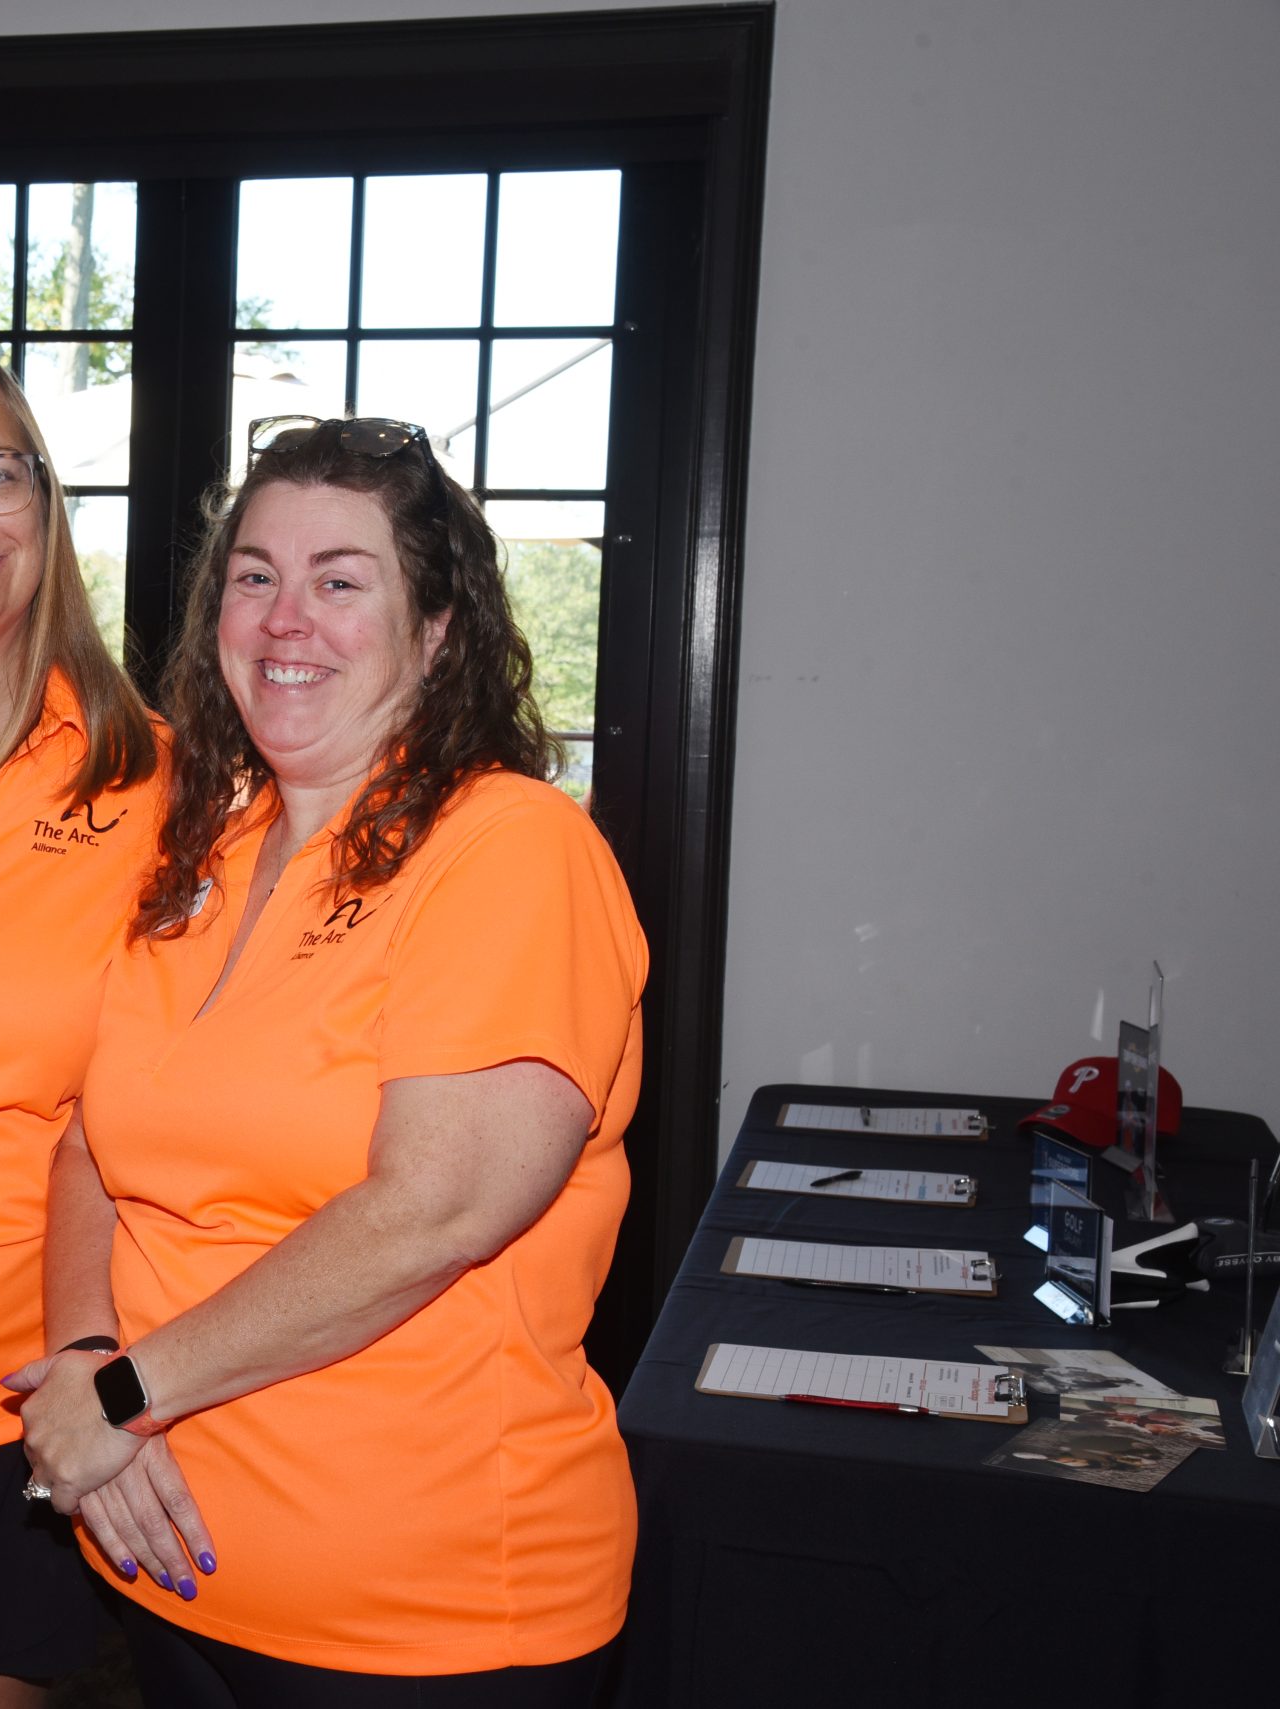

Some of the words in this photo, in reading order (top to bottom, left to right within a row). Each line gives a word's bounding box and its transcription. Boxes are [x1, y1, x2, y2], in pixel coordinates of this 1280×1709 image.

[34, 819, 64, 840] The
[67, 828, 100, 847] Arc.
[31, 842, 67, 855] Alliance
[299, 930, 322, 947] The
[1068, 1066, 1100, 1093] P
[1064, 1211, 1084, 1234] GOLF
